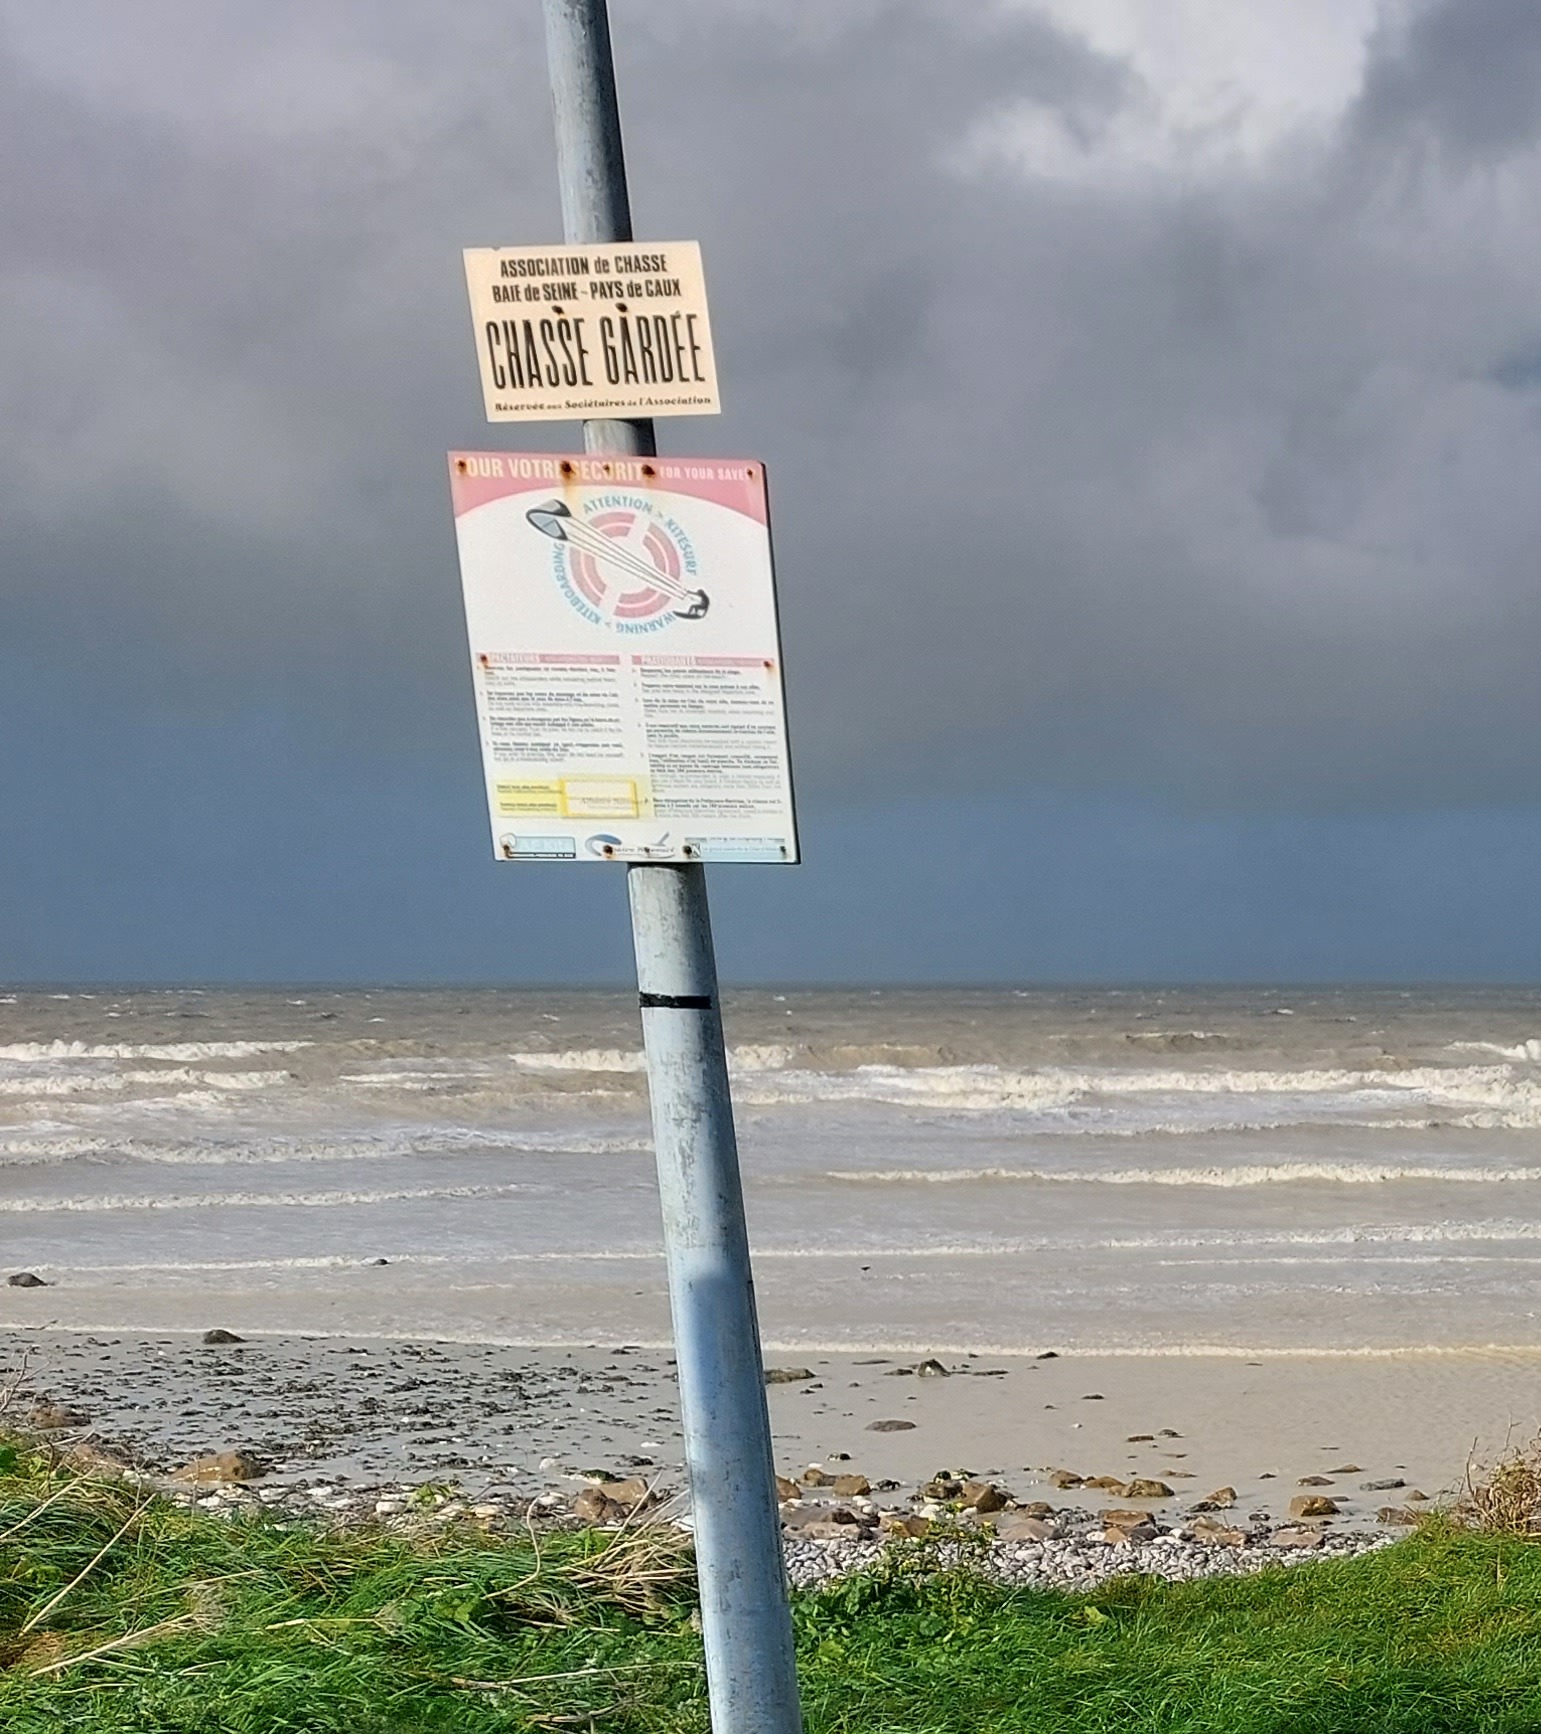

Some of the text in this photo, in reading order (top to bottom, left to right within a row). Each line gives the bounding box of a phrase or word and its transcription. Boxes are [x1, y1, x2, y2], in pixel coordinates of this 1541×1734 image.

[500, 254, 668, 277] ASSOCIATION de CHASSE
[492, 284, 522, 303] BAIE
[524, 283, 540, 301] de
[542, 282, 579, 301] SEINE
[589, 280, 624, 300] PAYS
[627, 280, 643, 298] de
[645, 278, 682, 297] CAUX
[485, 316, 594, 390] CHASSE
[568, 459, 649, 480] SECURIT
[660, 466, 681, 479] FOR
[683, 466, 714, 480] YOUR
[583, 495, 697, 576] ATTENTION KITESURF
[553, 542, 677, 634] KITEBOARDING WARNING
